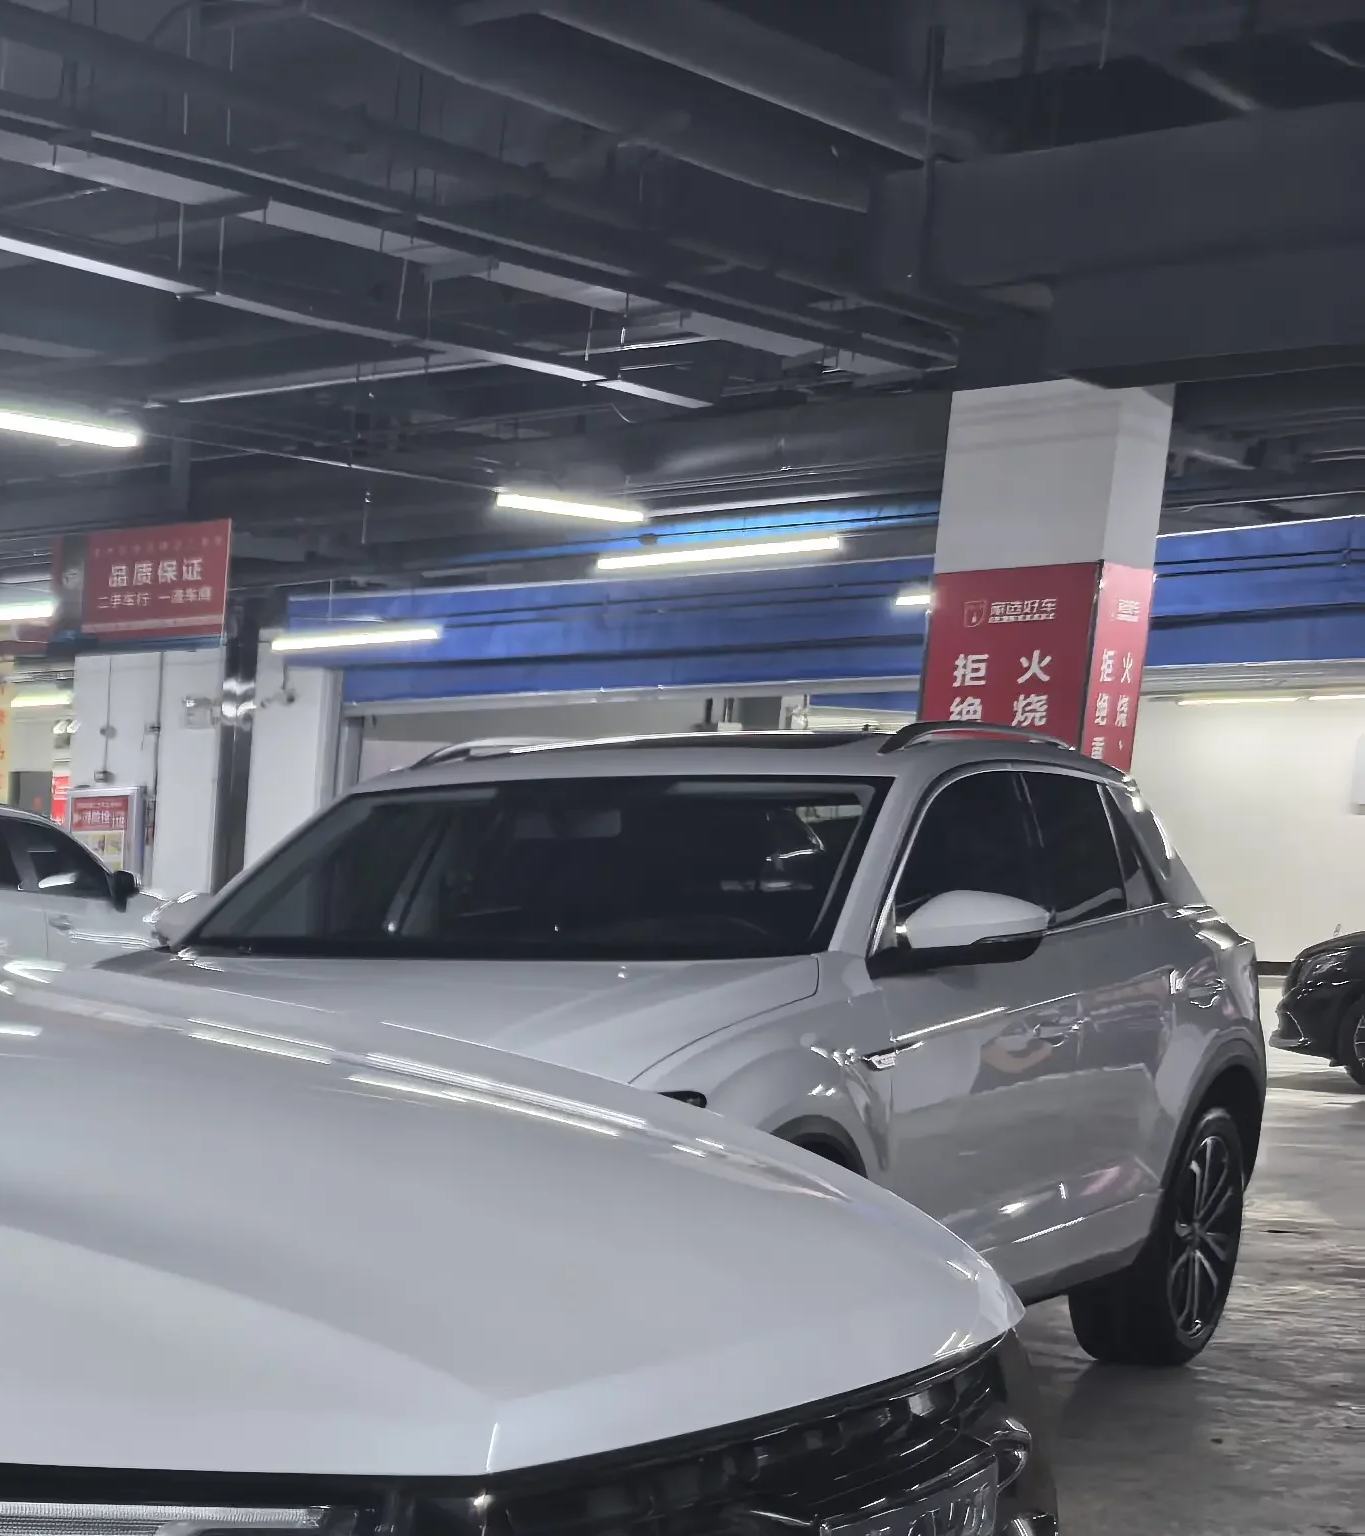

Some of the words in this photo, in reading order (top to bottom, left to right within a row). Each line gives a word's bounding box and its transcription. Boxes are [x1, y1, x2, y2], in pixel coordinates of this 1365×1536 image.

[109, 558, 203, 588] 品质保证
[949, 653, 990, 723] 拒绝
[1012, 649, 1052, 727] 火烧
